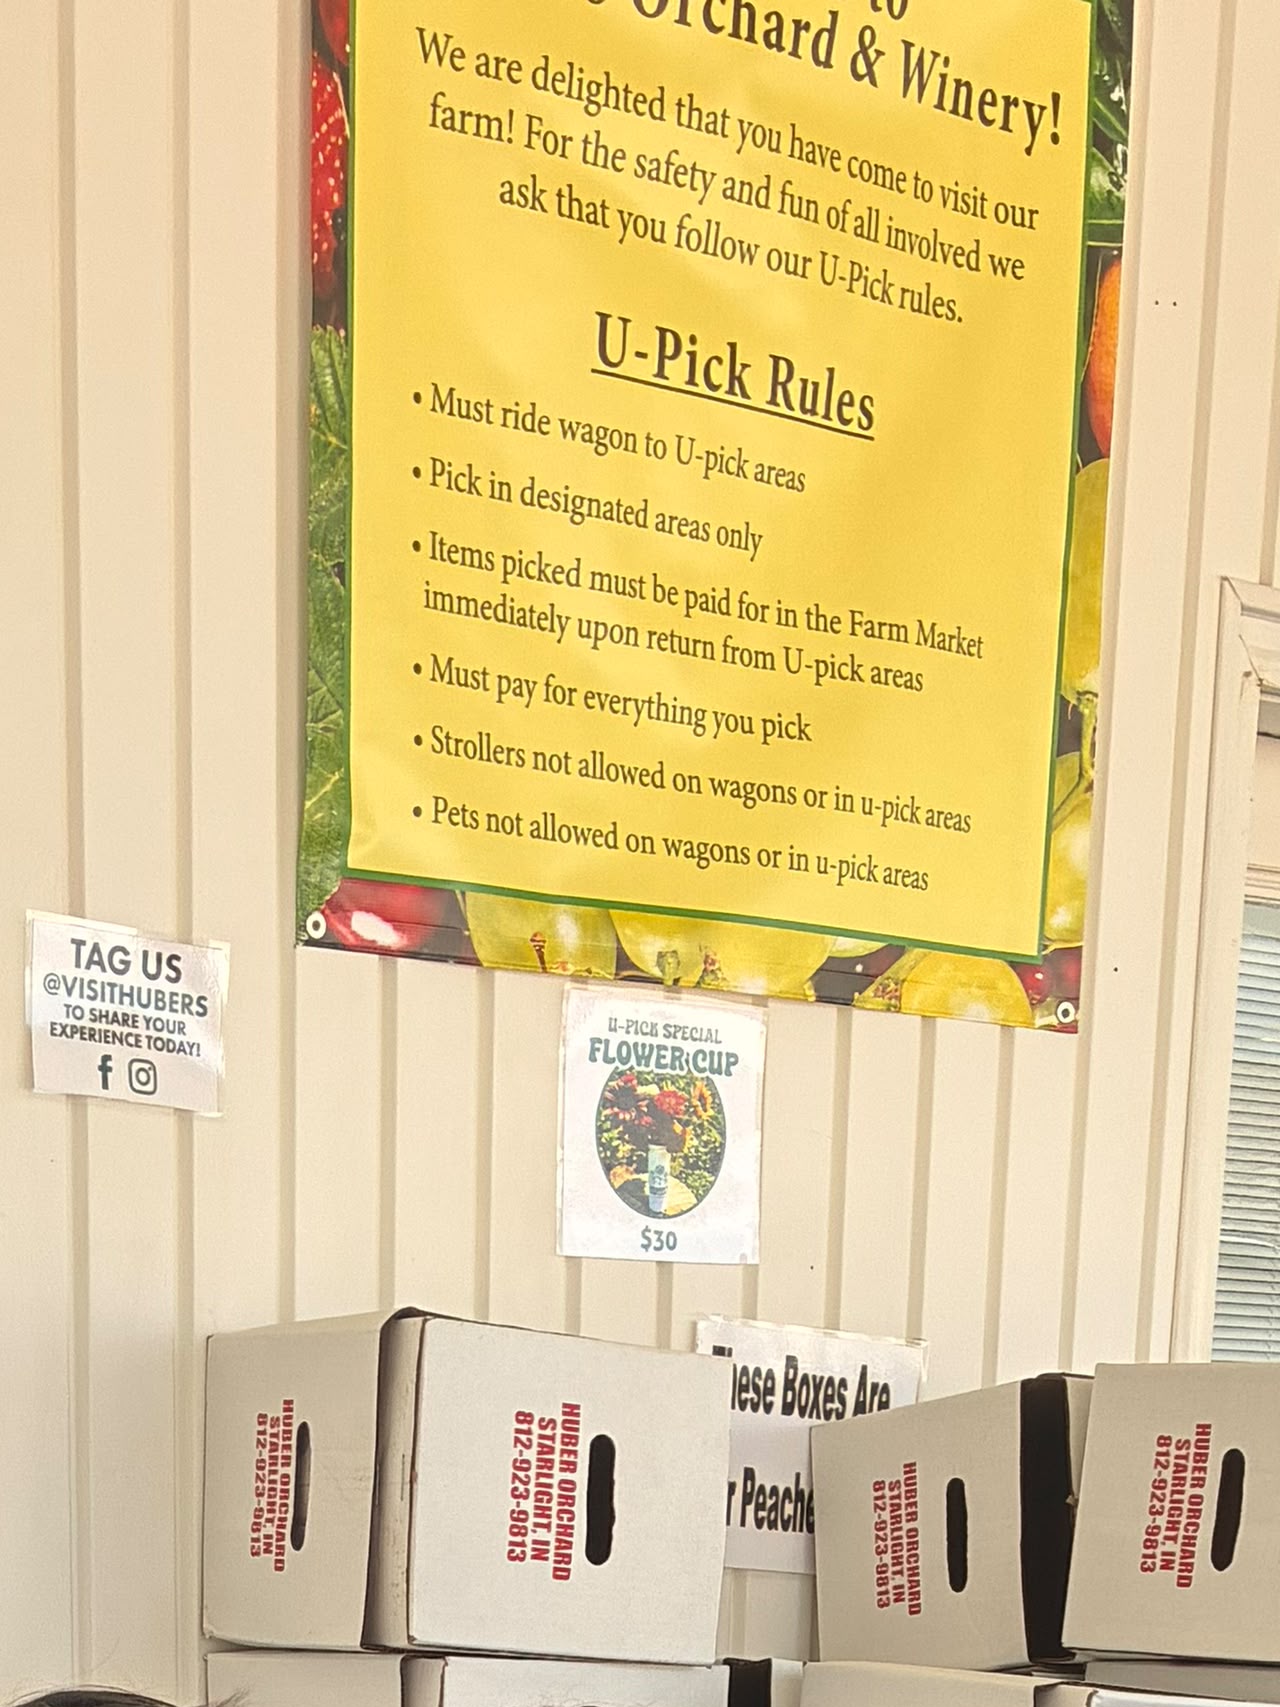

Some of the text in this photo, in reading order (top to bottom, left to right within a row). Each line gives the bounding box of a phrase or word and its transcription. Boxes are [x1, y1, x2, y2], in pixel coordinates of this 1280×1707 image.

[416, 27, 1039, 230] We are delighted that you have come to visit our
[850, 25, 885, 88] &
[901, 39, 1060, 156] Winery!
[429, 91, 1025, 280] farm! For the safety and fun of all involved we
[499, 174, 962, 323] ask that you follow our U-Pick rules.
[596, 311, 875, 431] U-Pick Rules
[430, 382, 805, 492] Must ride wagon to U-pick areas
[429, 457, 763, 562] Pick in designated areas only
[424, 580, 923, 692] immediately upon return from U-pick areas
[429, 531, 984, 659] Items picked must be paid for in the Farm Market
[430, 653, 812, 746] Must pay for everything you pick
[431, 725, 971, 833] Strollers not allowed on wagons or in u-pick areas
[432, 796, 928, 891] Pets not allowed on wagons or in u-pick areas
[43, 972, 209, 1018] @VISITHUBERS
[71, 938, 182, 984] TAG US
[50, 1022, 201, 1057] EXPERIENCE TODAY!
[63, 1003, 187, 1036] TO SHARE YOUR
[588, 1036, 739, 1077] FLOWER CUP
[608, 1017, 723, 1045] U-PICK SPECIAL
[640, 1225, 678, 1253] $30
[723, 1350, 890, 1421] ese Boxes Are
[507, 1411, 534, 1563] 812-923-9813
[552, 1402, 581, 1581] HUBER ORCHARD
[740, 1467, 815, 1534] Peache
[1140, 1435, 1172, 1574] 812-923-9813
[1176, 1424, 1212, 1588] HUBER ORCHARD
[530, 1539, 550, 1562] IN
[1160, 1551, 1176, 1571] IN
